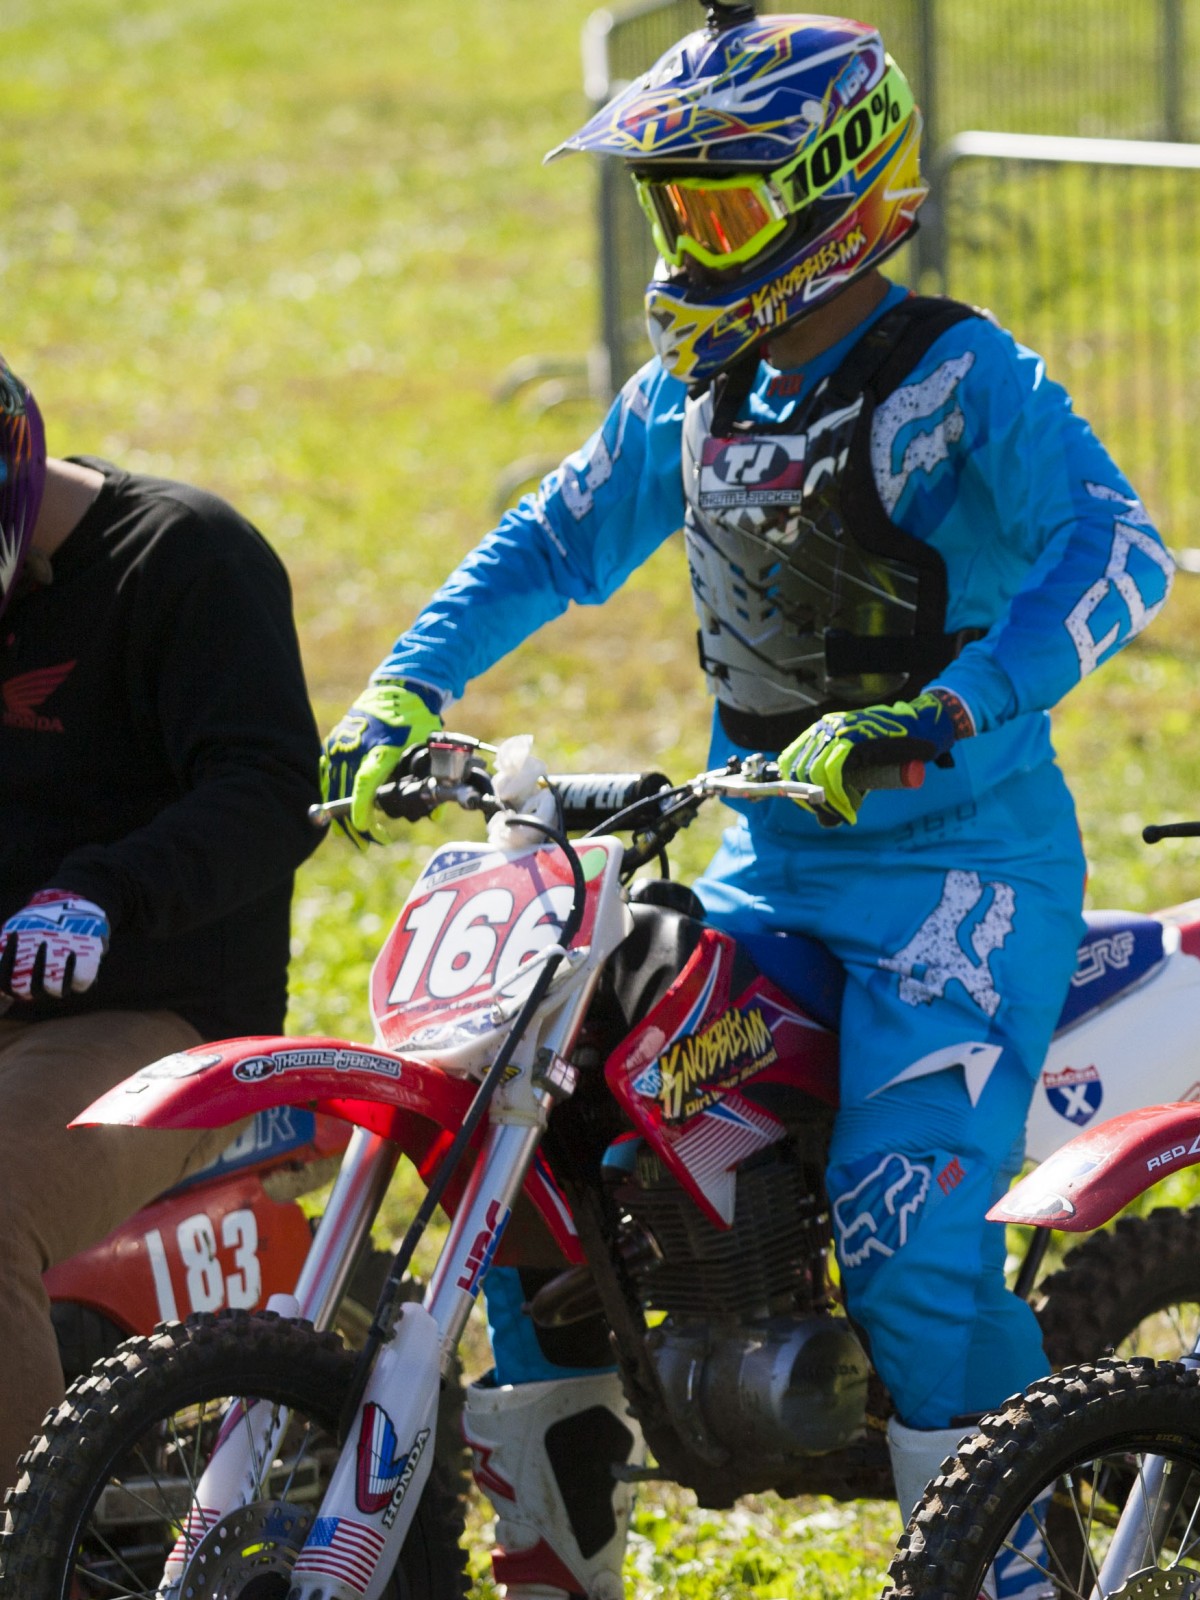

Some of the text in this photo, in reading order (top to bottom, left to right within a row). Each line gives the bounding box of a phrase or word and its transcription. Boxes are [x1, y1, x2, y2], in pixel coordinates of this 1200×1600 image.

[782, 83, 900, 206] 100%
[386, 885, 577, 1006] 166
[1044, 1070, 1098, 1088] RACER
[1059, 1085, 1095, 1117] X
[936, 1156, 967, 1196] FOX
[1146, 1145, 1187, 1172] RED
[145, 1209, 262, 1323] 183
[457, 1200, 502, 1292] HRC
[382, 1427, 430, 1528] HONDA
